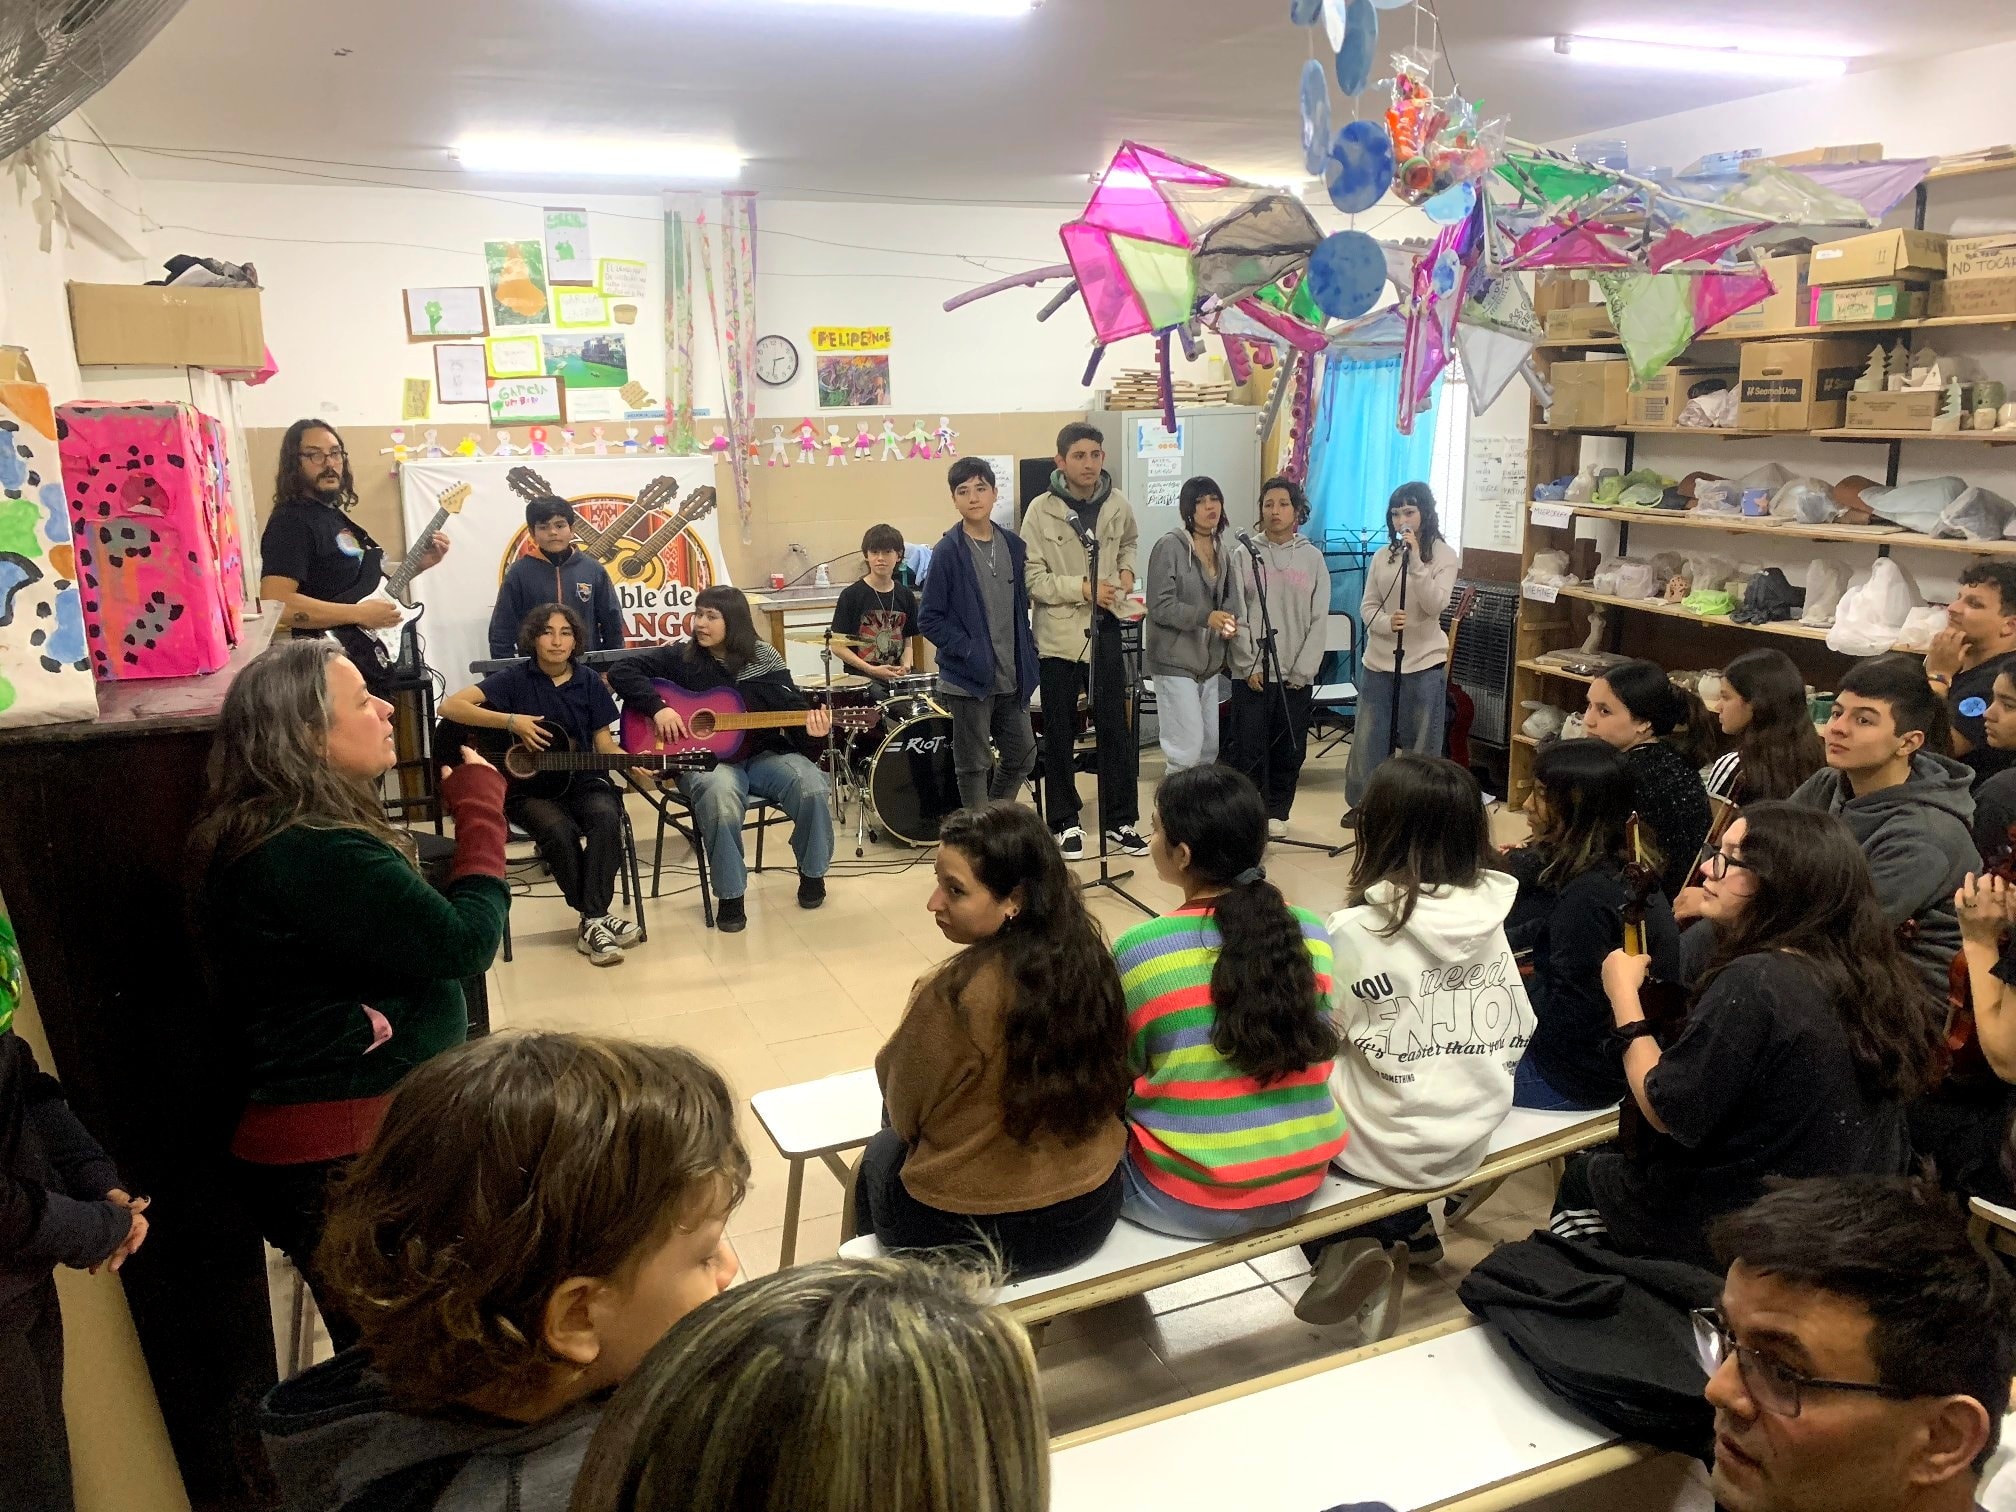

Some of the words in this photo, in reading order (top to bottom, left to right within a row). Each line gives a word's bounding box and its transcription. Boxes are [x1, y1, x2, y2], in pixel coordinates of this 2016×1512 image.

[1953, 261, 1971, 277] NO
[664, 584, 692, 606] de
[905, 735, 946, 754] RIOT
[1351, 973, 1393, 1000] YOU
[1420, 952, 1508, 997] need
[1398, 1044, 1441, 1062] easier
[1446, 1041, 1486, 1055] than
[1489, 1038, 1505, 1056] you
